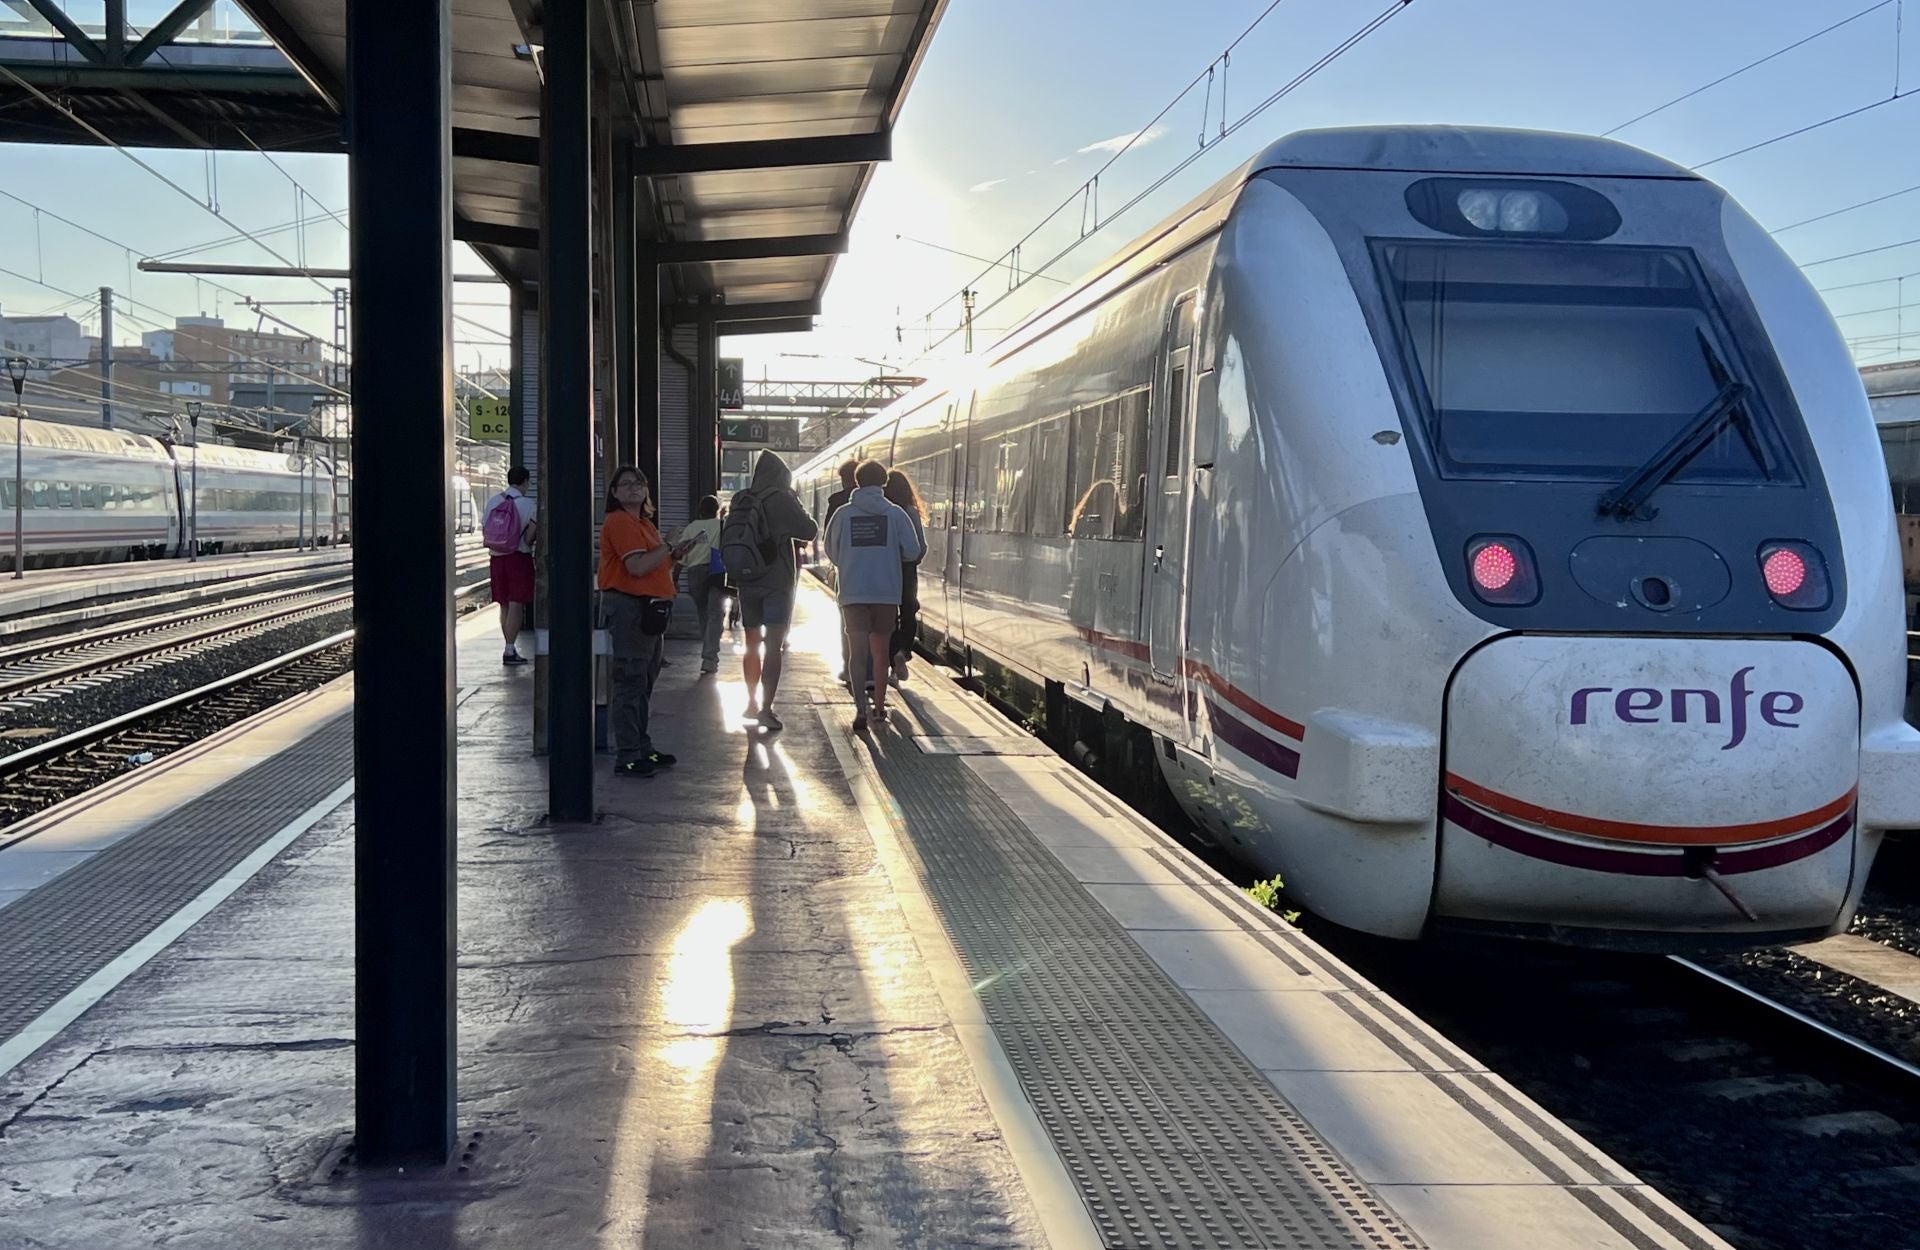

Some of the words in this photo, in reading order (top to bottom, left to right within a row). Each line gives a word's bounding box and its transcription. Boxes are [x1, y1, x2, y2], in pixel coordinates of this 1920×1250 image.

[720, 388, 742, 404] 4A
[476, 405, 482, 416] S
[482, 424, 508, 433] D.C.
[742, 460, 748, 471] 5
[1570, 666, 1804, 751] renfe
